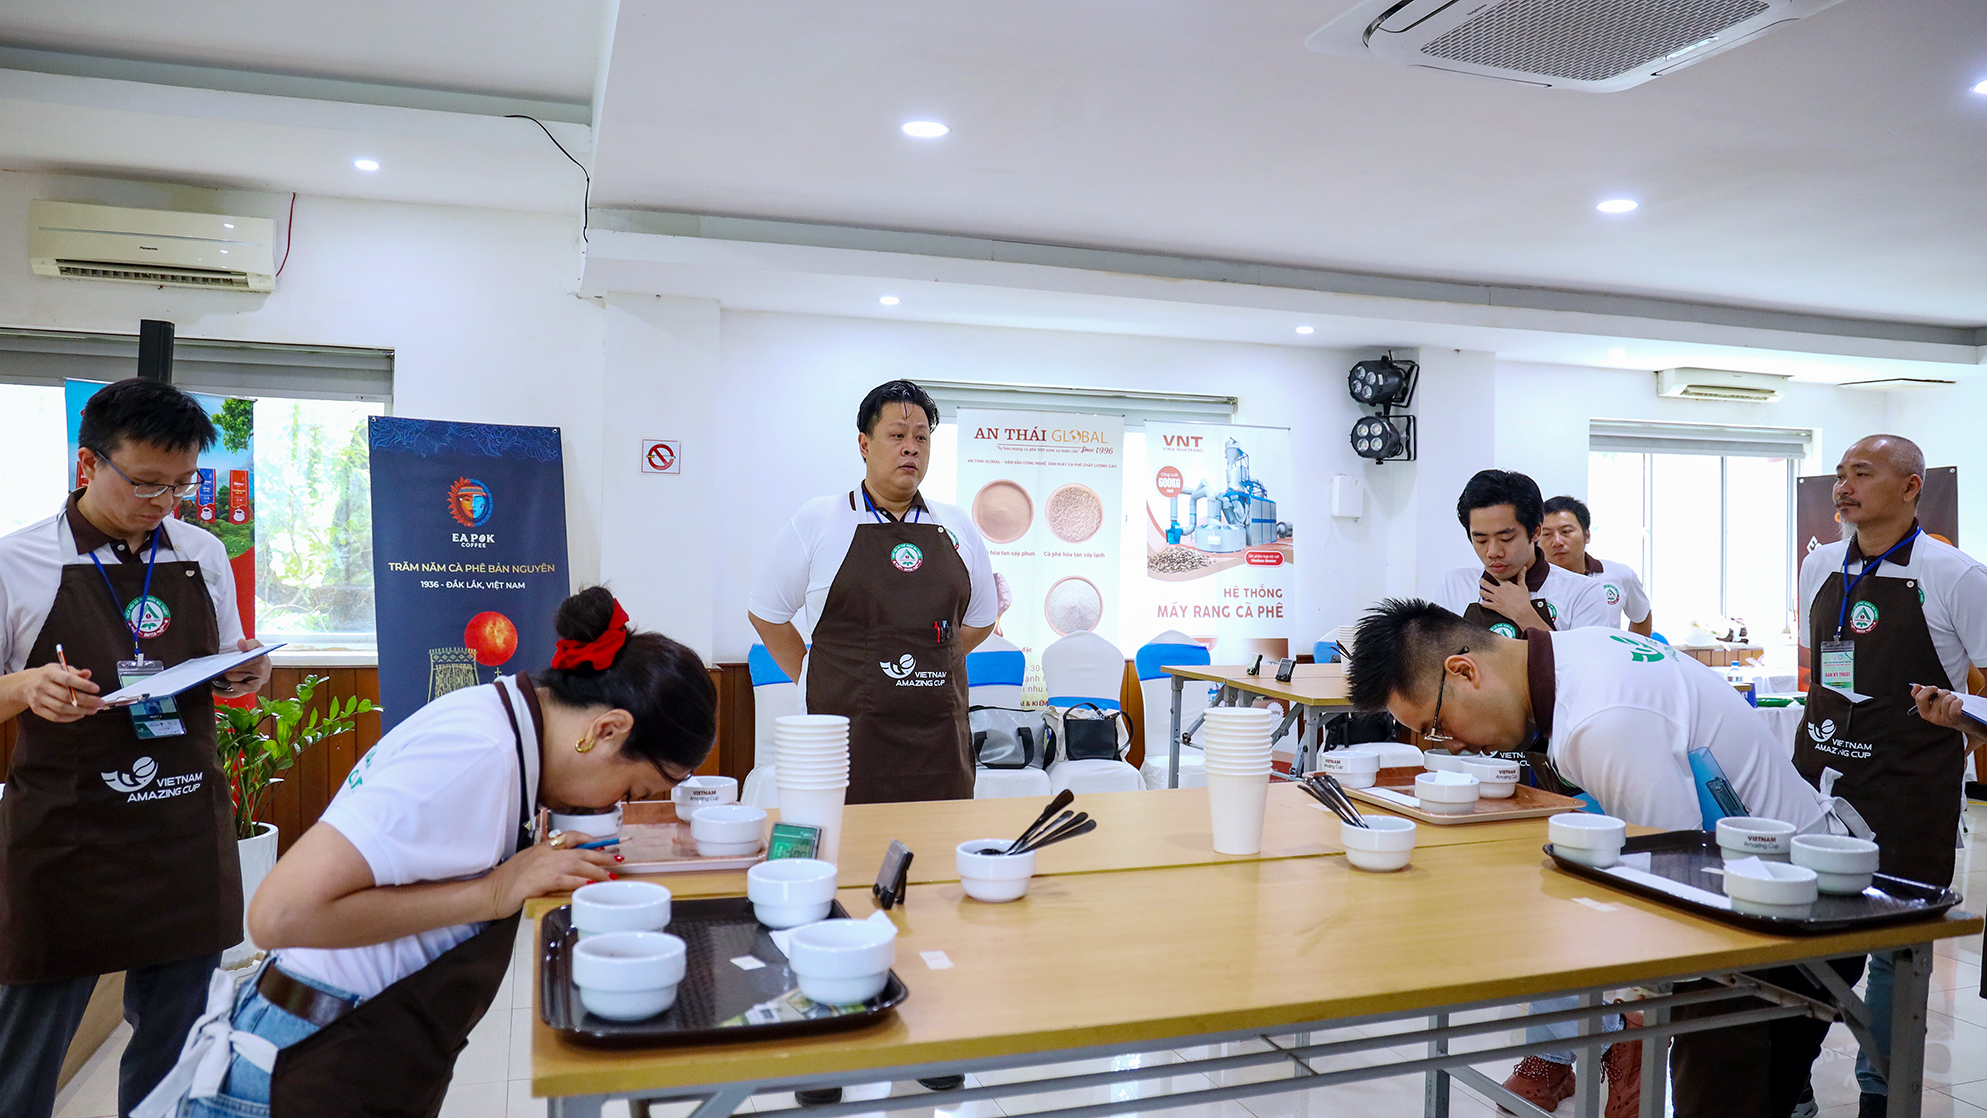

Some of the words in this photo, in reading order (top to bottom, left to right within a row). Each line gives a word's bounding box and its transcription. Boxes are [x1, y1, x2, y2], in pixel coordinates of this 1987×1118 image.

[974, 428, 999, 440] AN
[1005, 426, 1047, 442] THÁI
[1052, 429, 1108, 444] GLOBAL
[1163, 434, 1203, 447] VNT
[452, 533, 468, 542] EA
[471, 533, 495, 543] POK
[388, 561, 419, 572] TRĂM
[422, 562, 446, 572] NĂM
[448, 562, 463, 572] CÀ
[465, 563, 486, 572] PHÊ
[512, 563, 555, 573] NGUYÊN
[486, 581, 504, 590] VIỆT
[1224, 585, 1240, 599] HỆ
[1244, 584, 1283, 598] THỐNG
[1157, 601, 1188, 618] MÁY
[1194, 605, 1230, 618] RANG
[1236, 602, 1253, 618] CÀ
[1258, 602, 1283, 618] PHÊ
[157, 772, 203, 787] VIETNAM
[127, 786, 181, 803] AMAZING
[182, 783, 201, 794] CUP
[1744, 842, 1767, 850] Amazing
